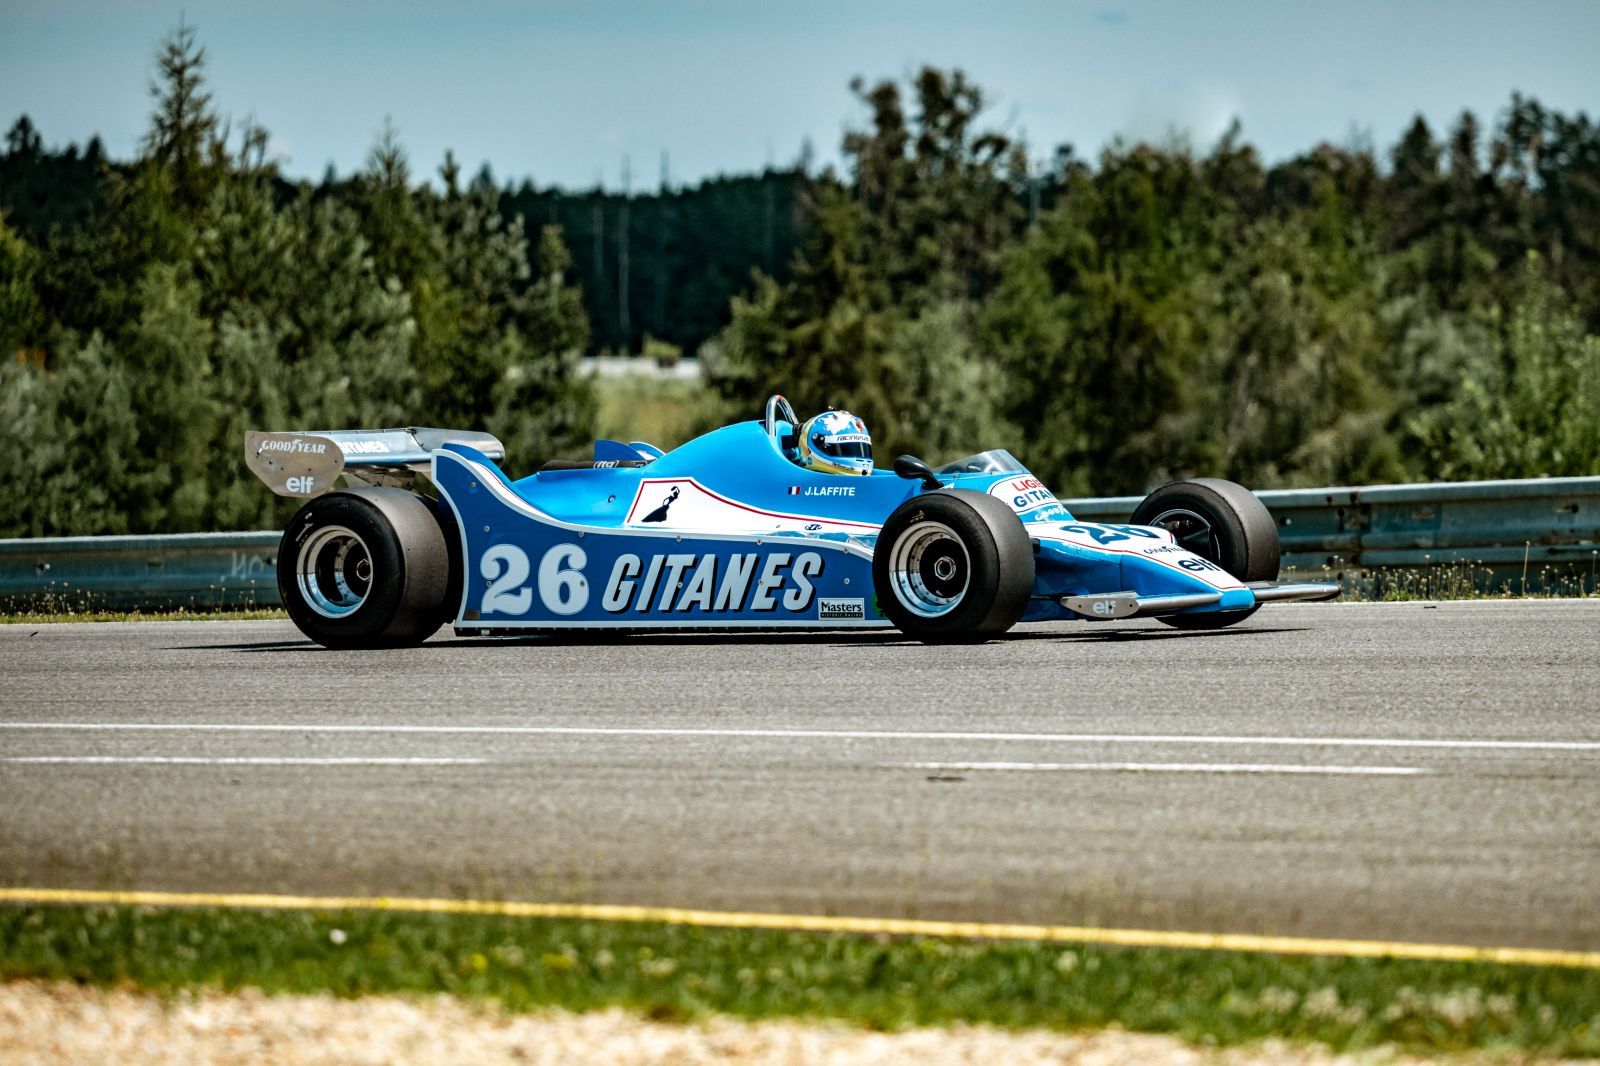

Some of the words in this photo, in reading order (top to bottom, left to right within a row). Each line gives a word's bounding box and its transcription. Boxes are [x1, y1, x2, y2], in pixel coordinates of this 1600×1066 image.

[261, 438, 326, 454] GOODYEAR
[286, 475, 314, 494] elf
[804, 486, 856, 497] J.LAFFITE
[1177, 558, 1222, 572] elf
[480, 543, 590, 616] 26
[602, 551, 825, 614] GITANES
[820, 600, 862, 612] Masters
[1092, 600, 1116, 615] elf
